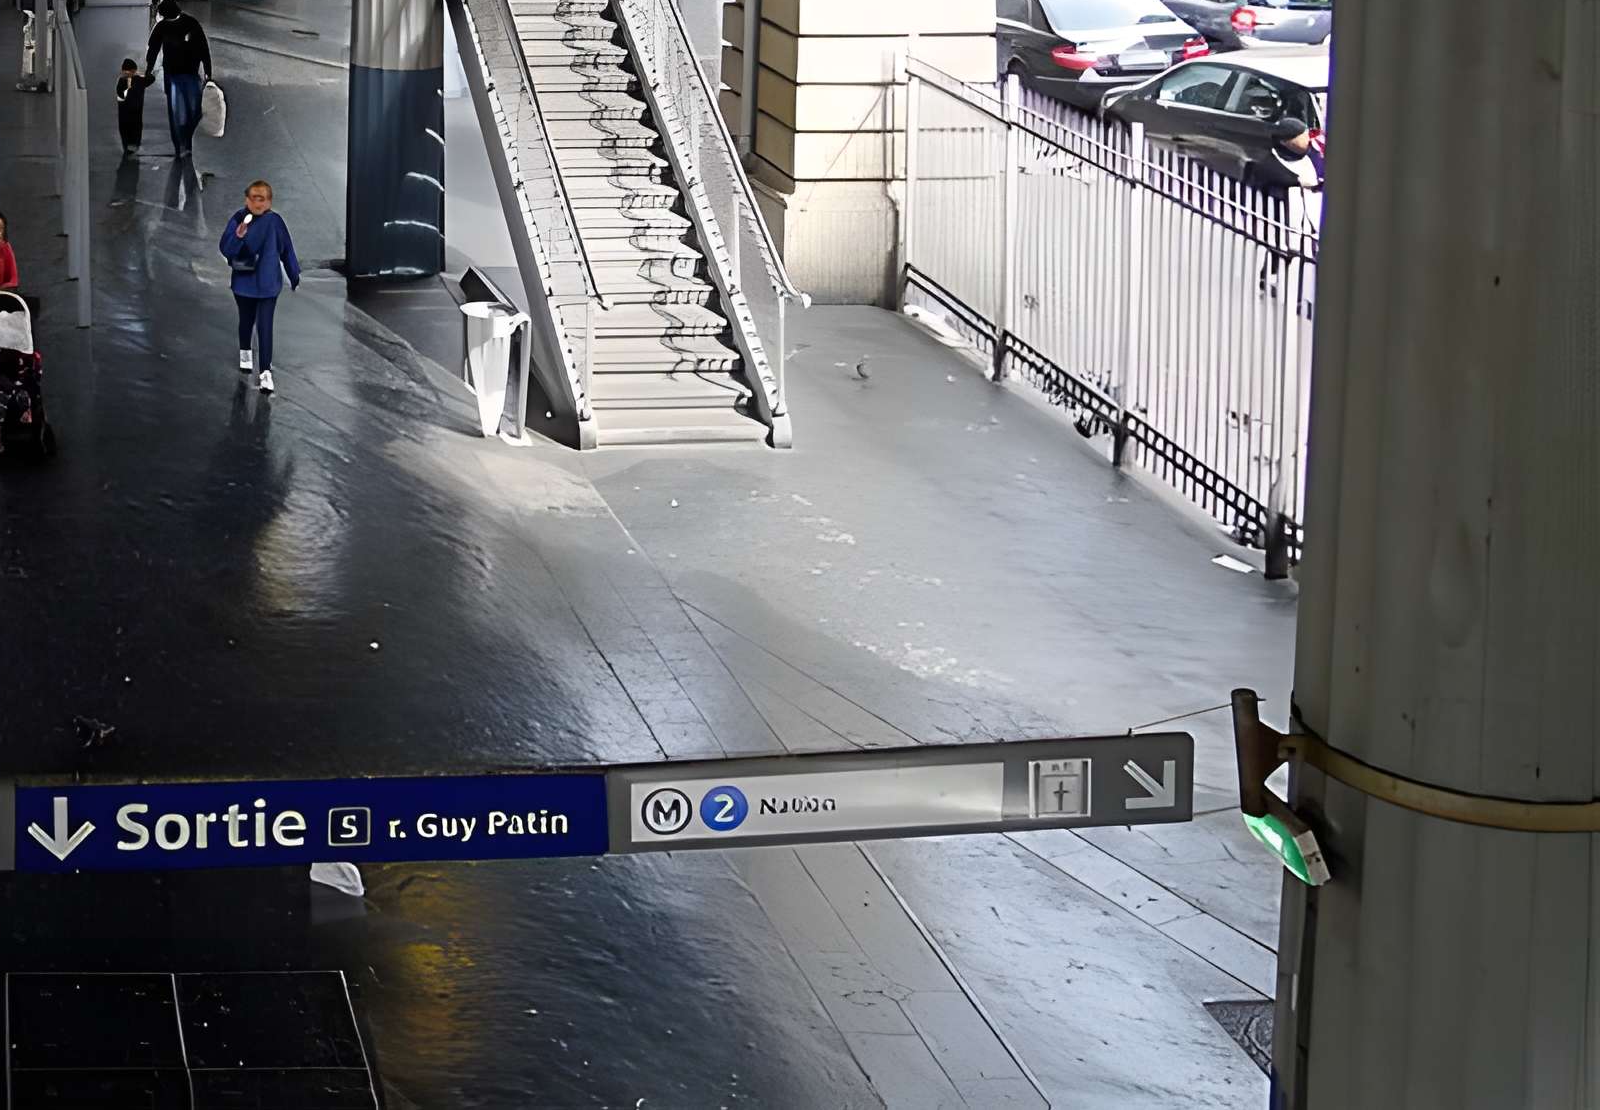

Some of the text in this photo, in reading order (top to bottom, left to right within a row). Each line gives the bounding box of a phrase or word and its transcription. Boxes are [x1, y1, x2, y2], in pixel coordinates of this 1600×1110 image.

[116, 797, 308, 852] Sortie
[388, 819, 407, 840] r.
[415, 812, 477, 842] Guy
[487, 809, 569, 836] Patin
[713, 792, 736, 823] 2
